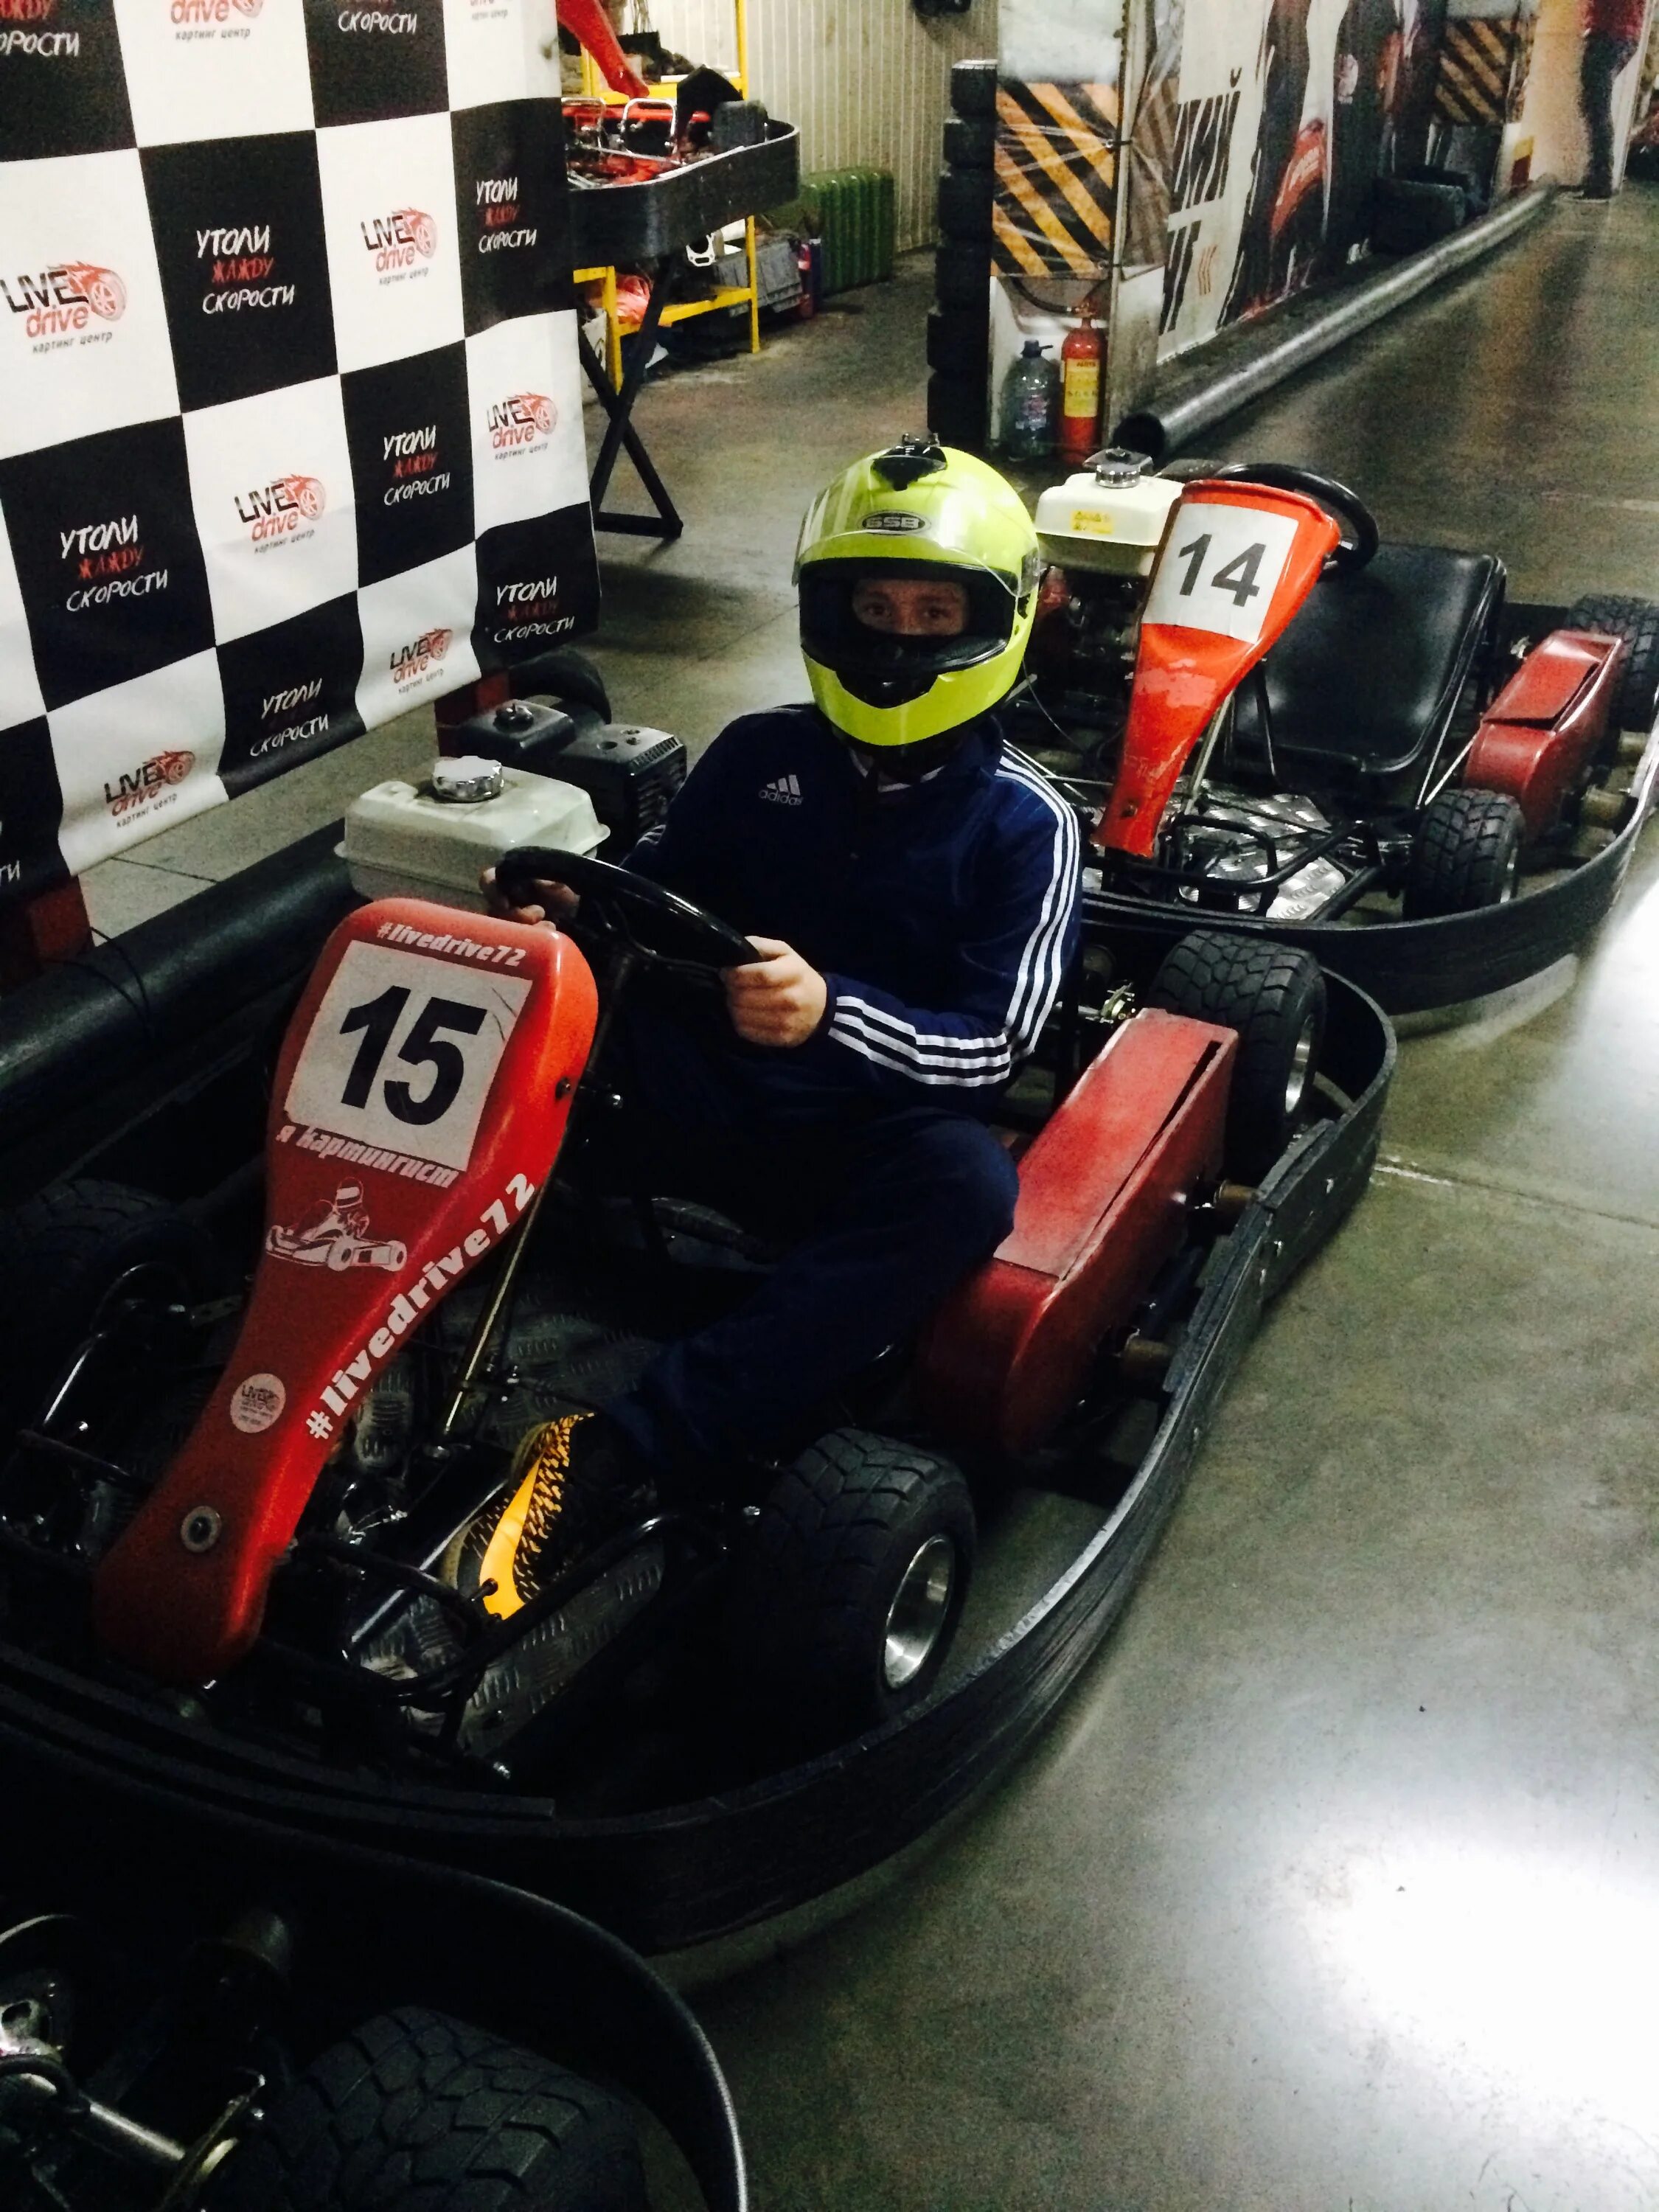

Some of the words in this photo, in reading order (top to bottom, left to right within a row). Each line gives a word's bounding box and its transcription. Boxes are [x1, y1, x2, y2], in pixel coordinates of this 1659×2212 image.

[175, 30, 216, 43] картинг
[220, 28, 251, 41] центр
[338, 10, 418, 35] СКОРОСТИ
[476, 176, 518, 205] УТОЛИ
[196, 224, 270, 258] УТОЛИ
[361, 215, 415, 251] LIVE
[479, 229, 538, 254] СКОРОСТИ
[376, 244, 415, 272] drive
[0, 270, 89, 313] LIVE
[202, 284, 295, 314] СКОРОСТИ
[26, 304, 89, 338] drive
[32, 337, 75, 354] картинг
[80, 332, 113, 345] центр
[487, 399, 535, 432] LIVE
[383, 425, 437, 460] УТОЛИ
[493, 425, 535, 449] drive
[234, 482, 299, 523] LIVE
[384, 472, 451, 506] СКОРОСТИ
[60, 514, 139, 559] УТОЛИ
[251, 511, 299, 541] drive
[1178, 533, 1267, 608] 14
[66, 568, 168, 612] СКОРОСТИ
[497, 575, 557, 606] УТОЛИ
[494, 616, 575, 643] СКОРОСТИ
[390, 637, 431, 670] LIVE
[261, 678, 322, 720] УТОЛИ
[250, 713, 329, 757] СКОРОСТИ
[104, 762, 164, 804] LIVE
[759, 789, 804, 806] adidas
[377, 922, 528, 967] #livedrive72
[339, 984, 488, 1125] 15
[305, 1172, 535, 1440] #livedrive72
